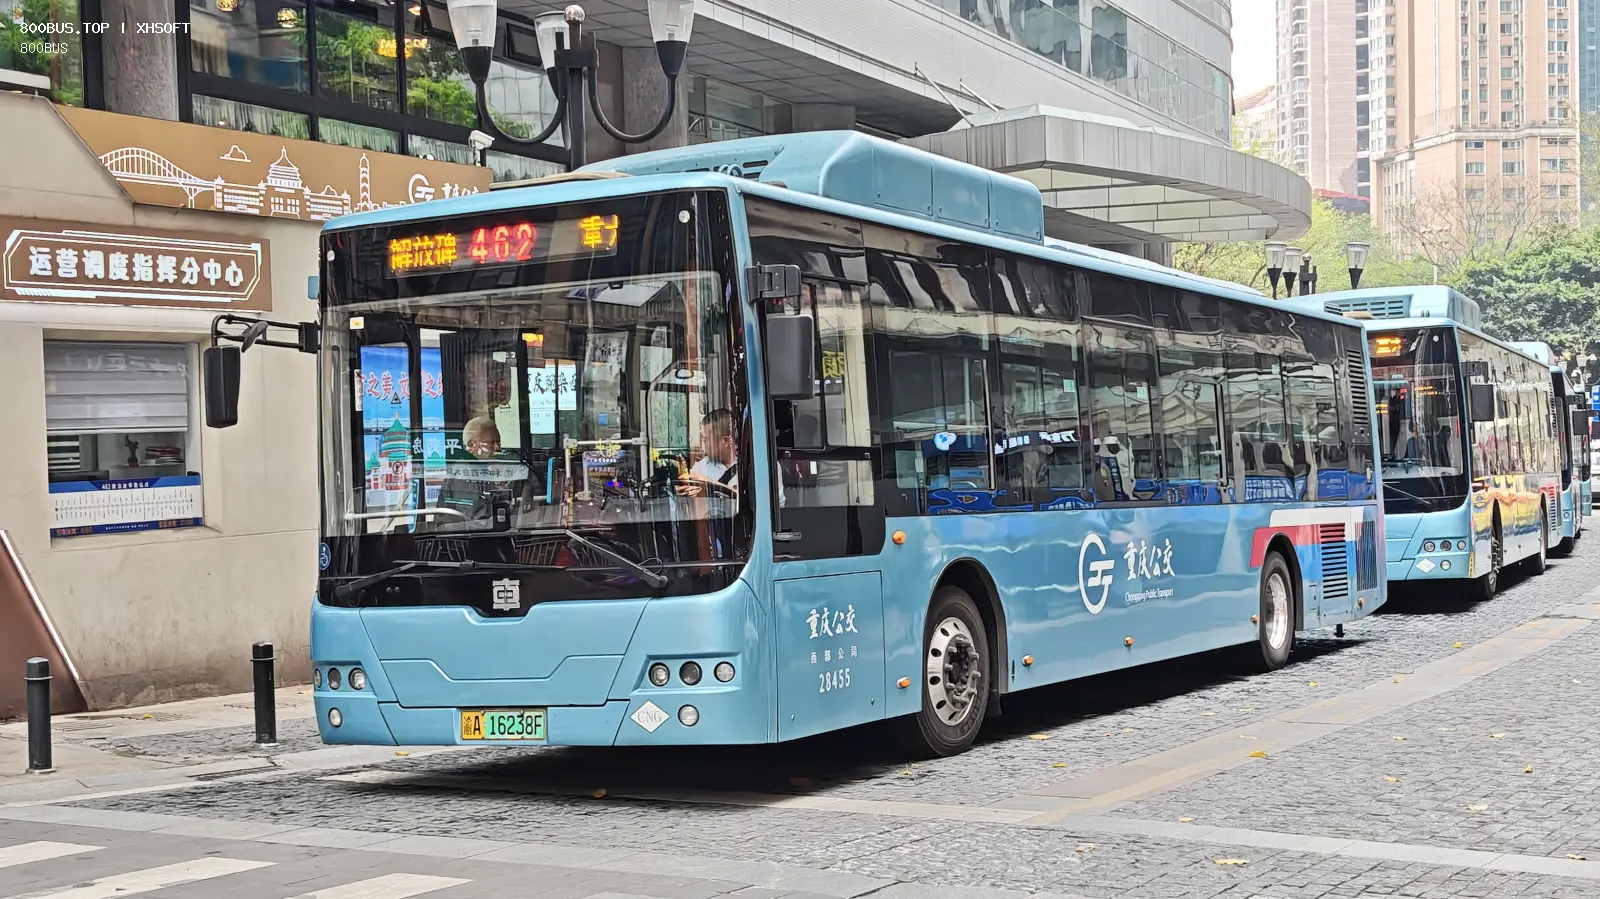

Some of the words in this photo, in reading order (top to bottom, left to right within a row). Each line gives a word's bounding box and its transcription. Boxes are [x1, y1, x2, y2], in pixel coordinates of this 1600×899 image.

[388, 231, 458, 271] 解放碑
[469, 222, 537, 264] 462
[29, 246, 244, 287] 运营调度指挥分中心
[1123, 538, 1176, 581] 重庆公交
[805, 604, 859, 639] 重庆公交
[819, 667, 851, 694] 28455
[637, 709, 662, 724] CNG
